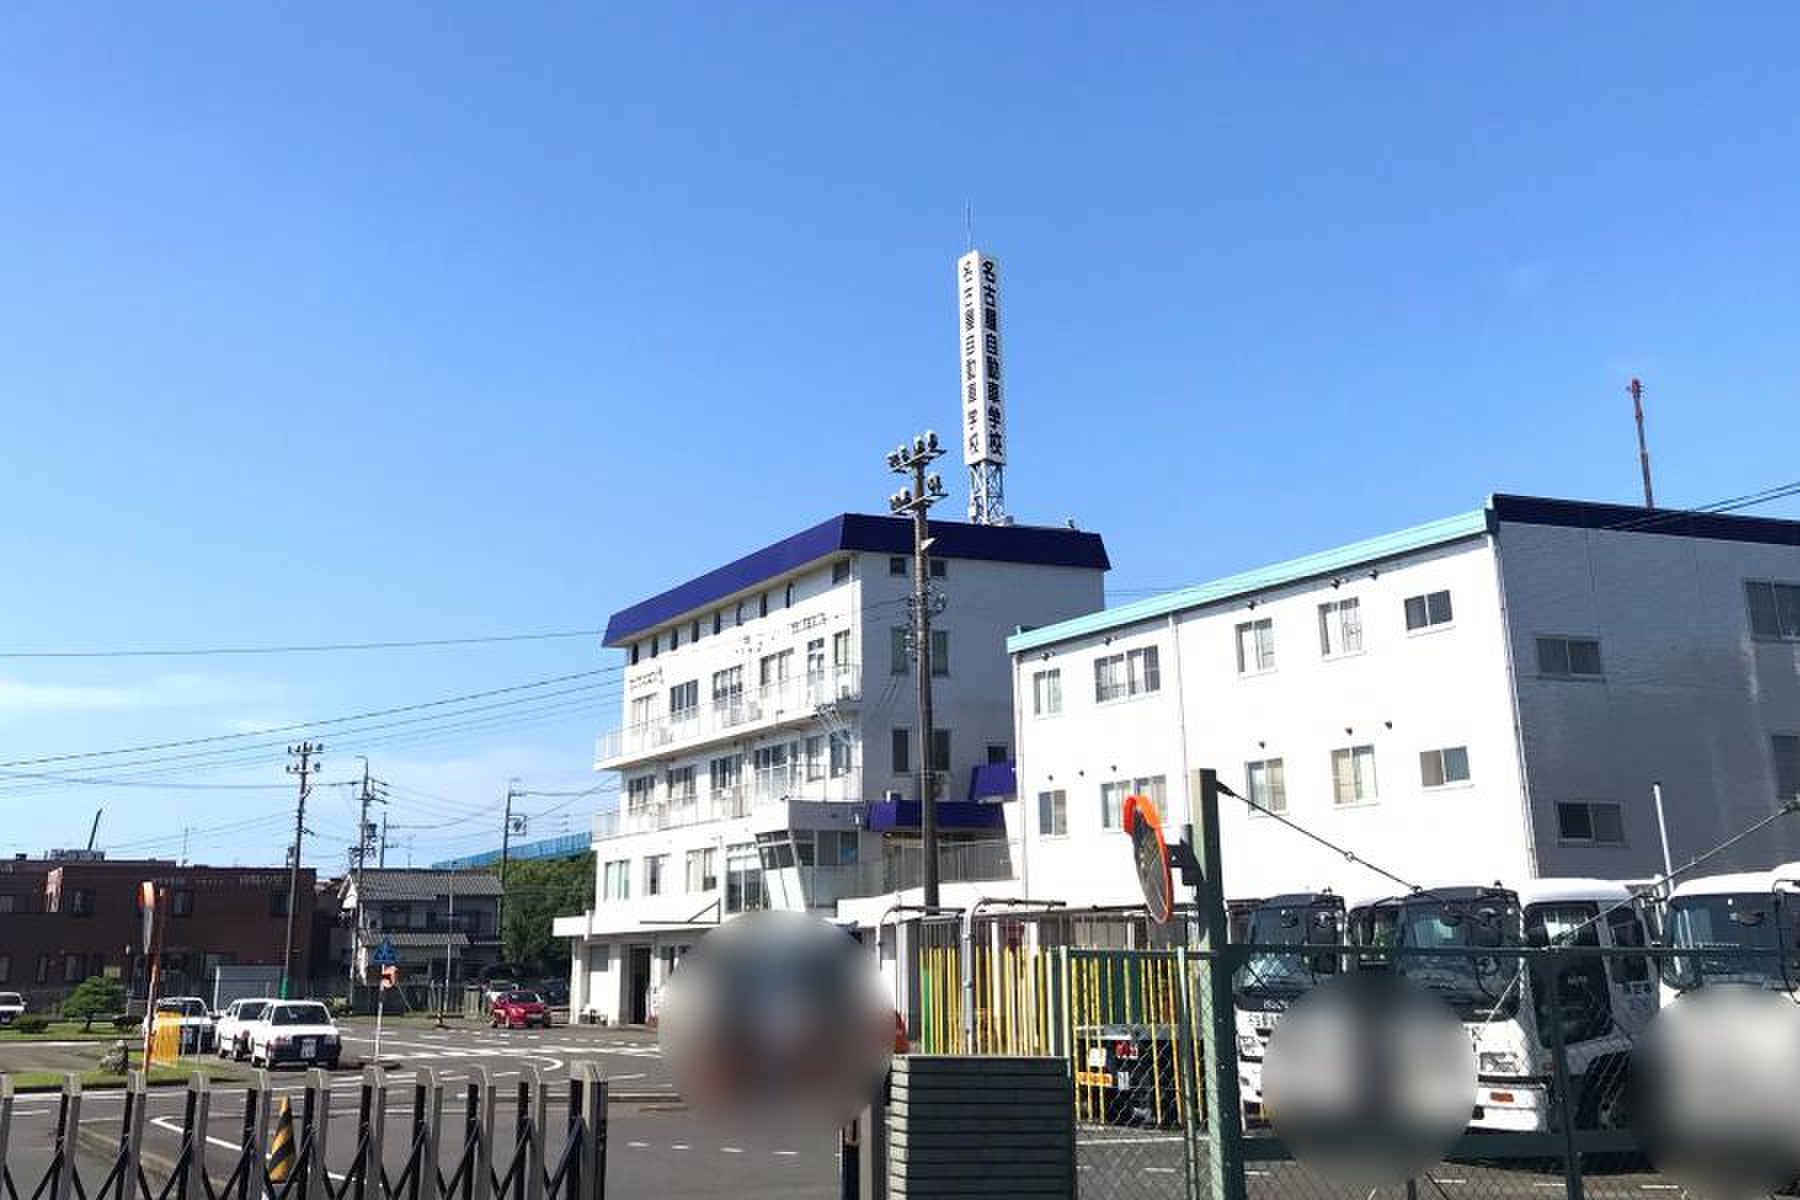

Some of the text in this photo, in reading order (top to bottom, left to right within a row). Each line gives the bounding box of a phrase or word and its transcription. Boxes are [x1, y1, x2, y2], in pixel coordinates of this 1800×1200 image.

[982, 260, 1003, 457] 名古屋自動車学校
